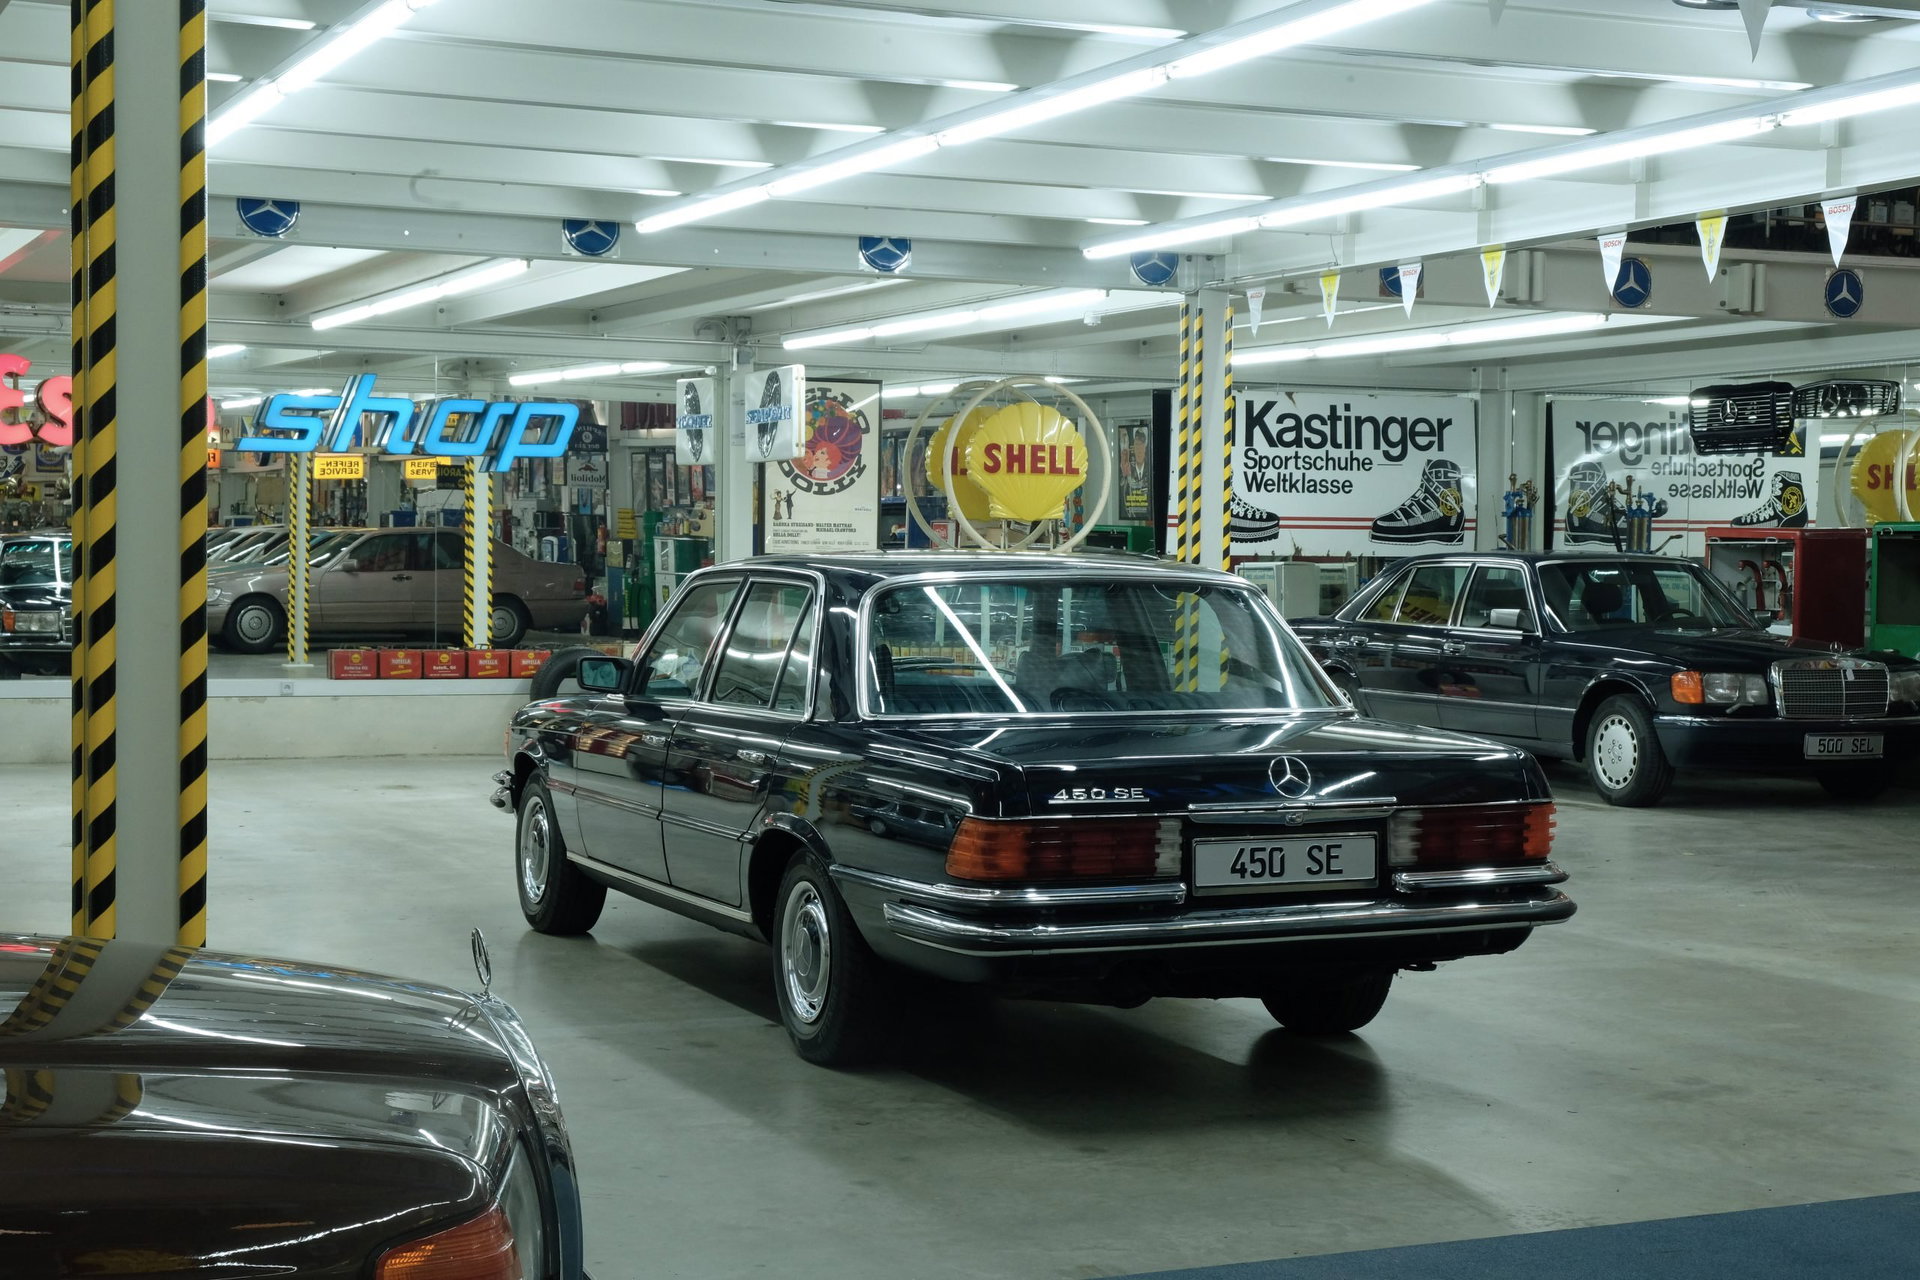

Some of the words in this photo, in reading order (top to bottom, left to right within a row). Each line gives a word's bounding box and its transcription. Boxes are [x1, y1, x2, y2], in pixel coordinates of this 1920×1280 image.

[1828, 203, 1851, 215] BOSCH
[1603, 239, 1622, 249] BOSCH
[1402, 269, 1418, 277] BOSCH
[234, 373, 579, 472] shop
[804, 387, 870, 435] ELLO
[1244, 400, 1453, 463] Kastinger
[983, 442, 1081, 475] SHELL
[1243, 447, 1374, 474] Sportschuhe
[776, 453, 867, 496] DOLLY
[1243, 471, 1354, 495] Weltklasse
[1817, 738, 1843, 754] 500
[1851, 737, 1875, 754] SEL
[1053, 787, 1107, 801] 450
[1113, 787, 1145, 800] SE
[1230, 847, 1286, 879] 450
[1306, 843, 1344, 876] SE
